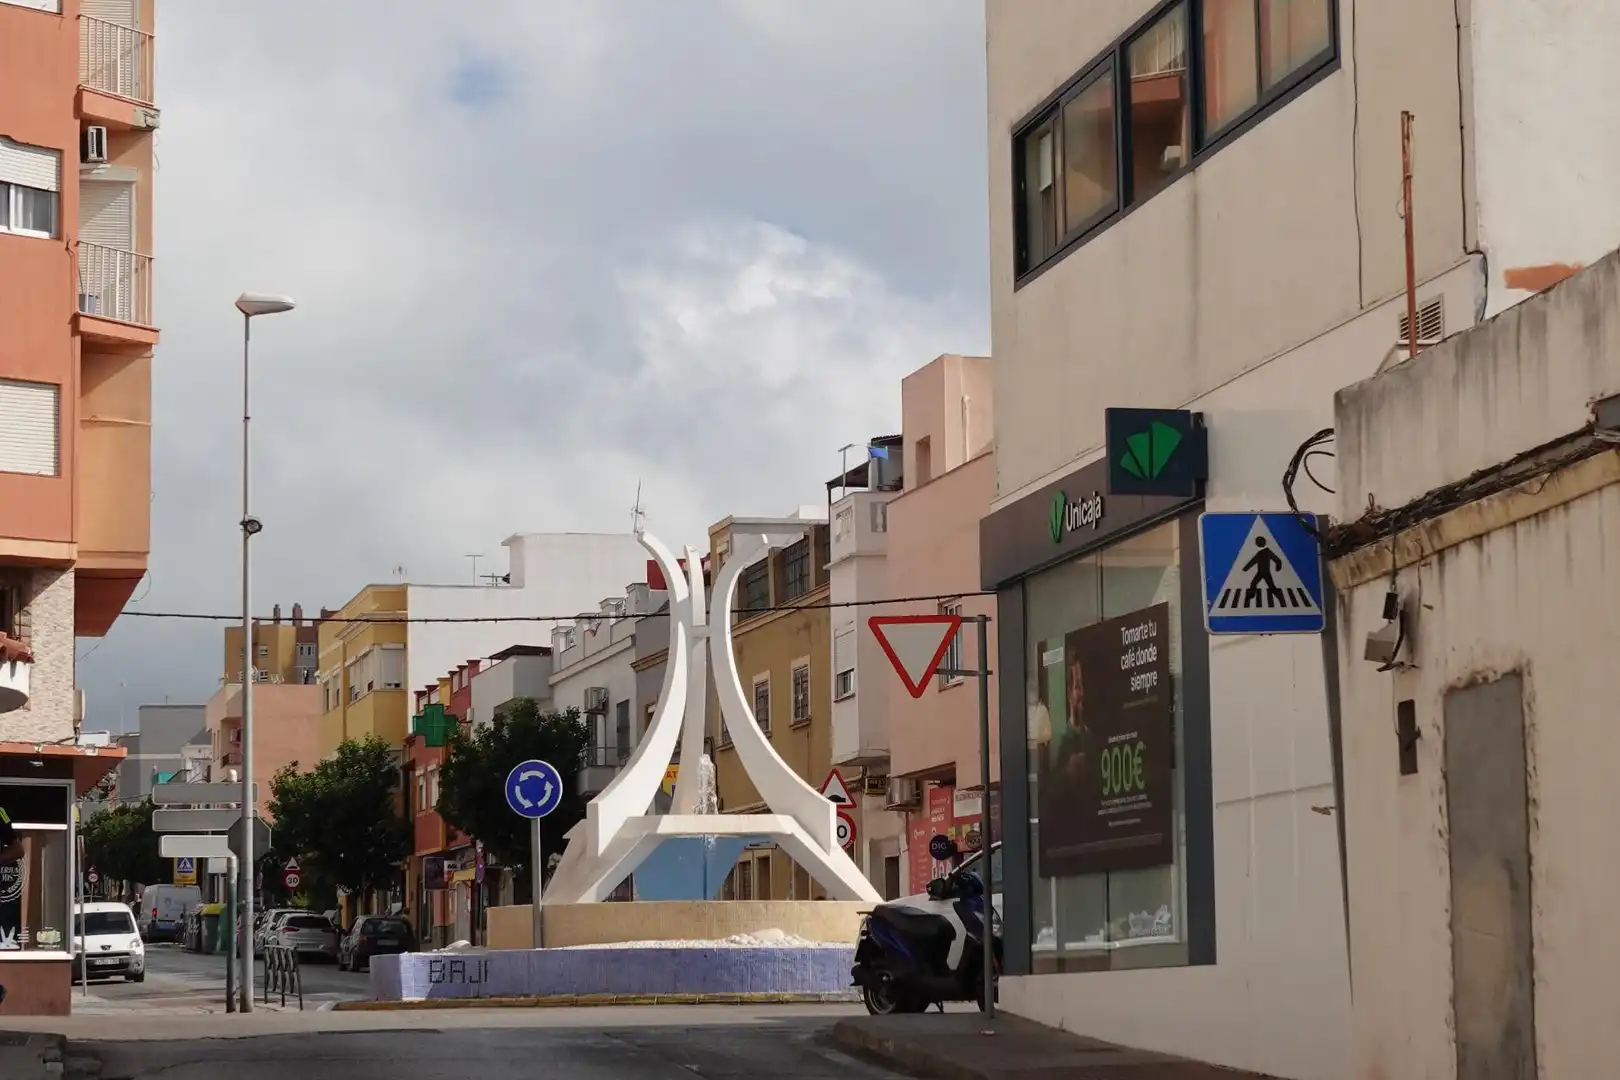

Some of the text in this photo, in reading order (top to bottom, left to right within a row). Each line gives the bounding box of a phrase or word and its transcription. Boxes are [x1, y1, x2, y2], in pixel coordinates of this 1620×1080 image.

[1065, 491, 1102, 532] Unicaja
[1120, 619, 1157, 646] Tomarte tu
[1120, 643, 1158, 670] café donde
[1130, 671, 1158, 694] siempre
[1101, 741, 1145, 796] 900€
